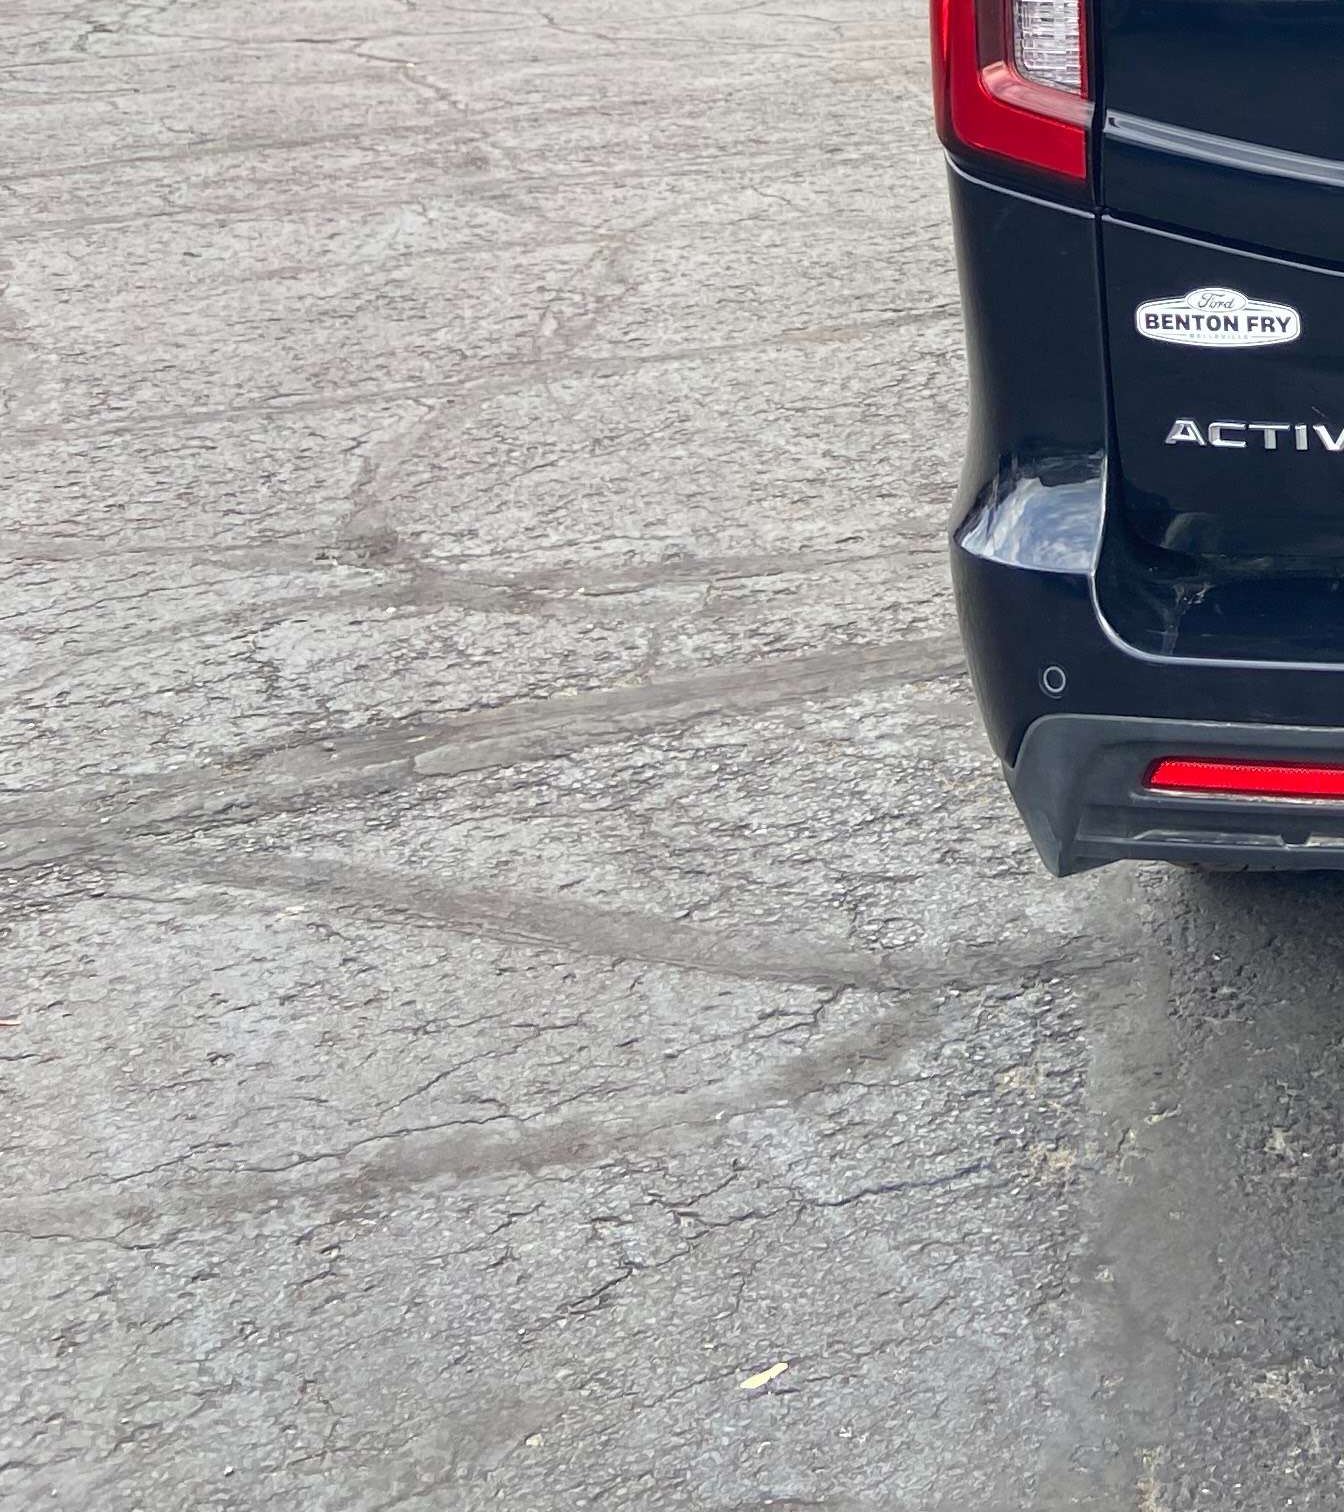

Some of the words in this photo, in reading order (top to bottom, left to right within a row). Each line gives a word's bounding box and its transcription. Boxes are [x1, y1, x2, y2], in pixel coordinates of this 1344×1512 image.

[1197, 292, 1236, 309] Ford
[1145, 313, 1239, 332] BENTON
[1247, 315, 1293, 334] FRY
